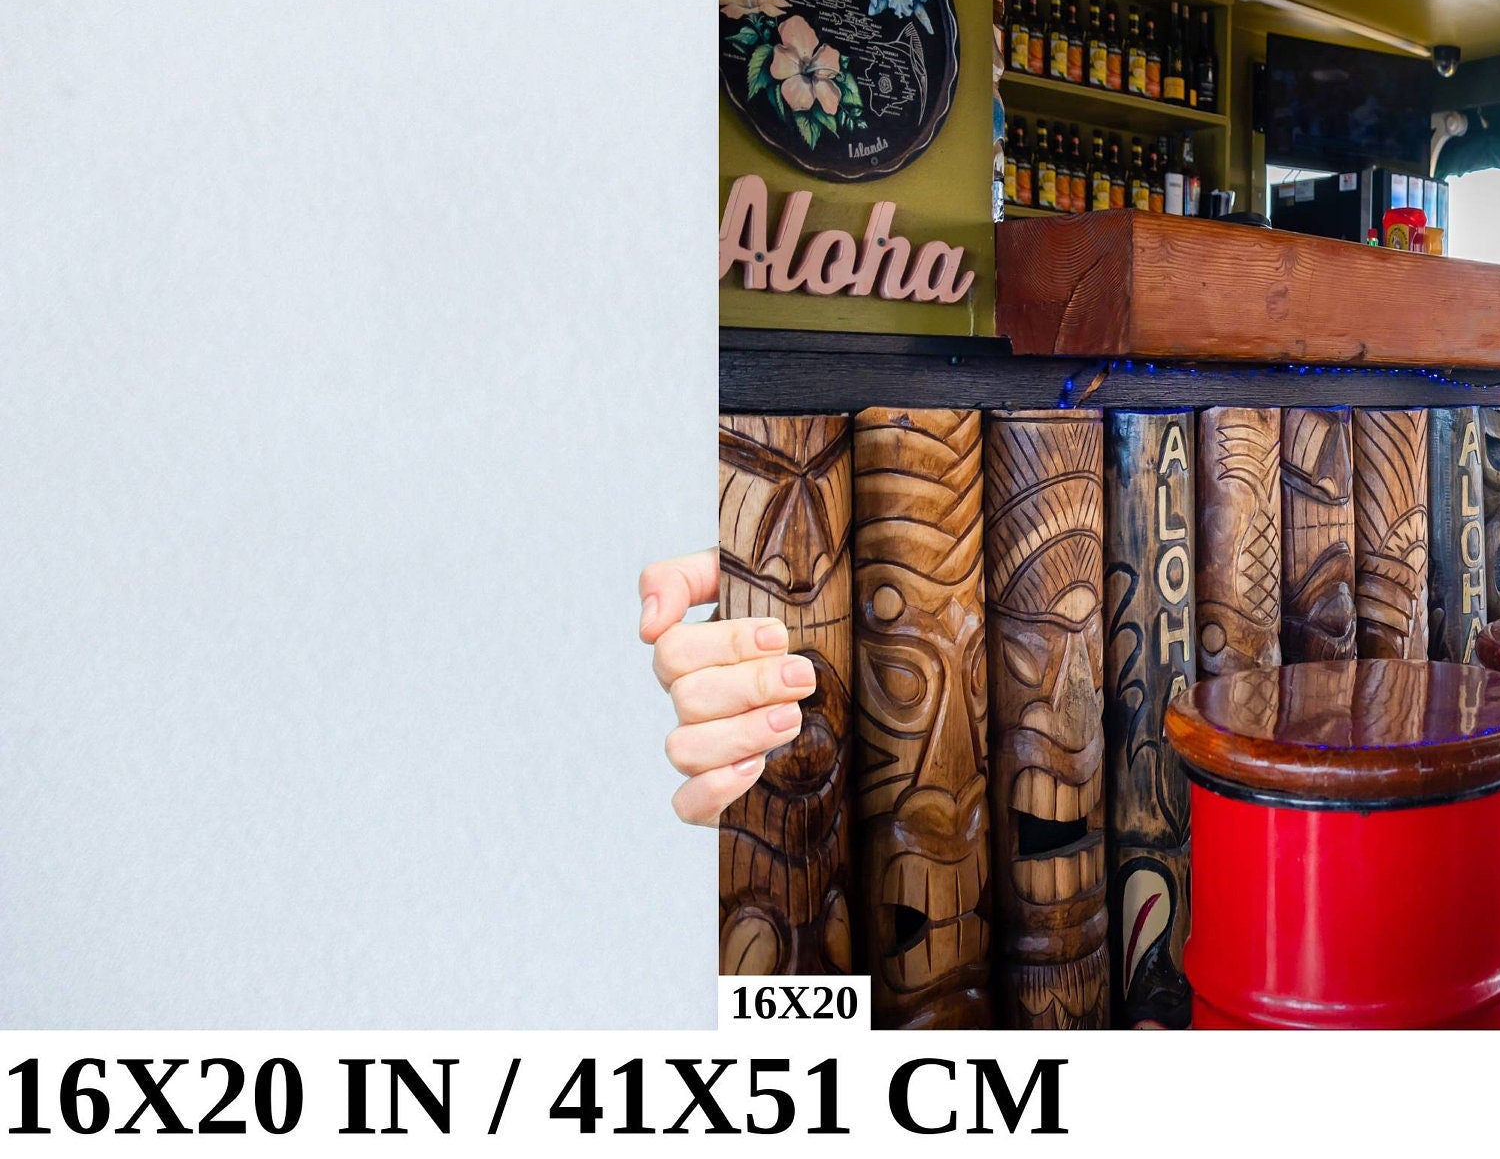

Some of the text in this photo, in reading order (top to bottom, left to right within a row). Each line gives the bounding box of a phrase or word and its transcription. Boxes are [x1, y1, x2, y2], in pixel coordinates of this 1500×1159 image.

[849, 137, 888, 158] Islands
[719, 174, 975, 304] Aloha
[1459, 422, 1486, 664] ALOHA
